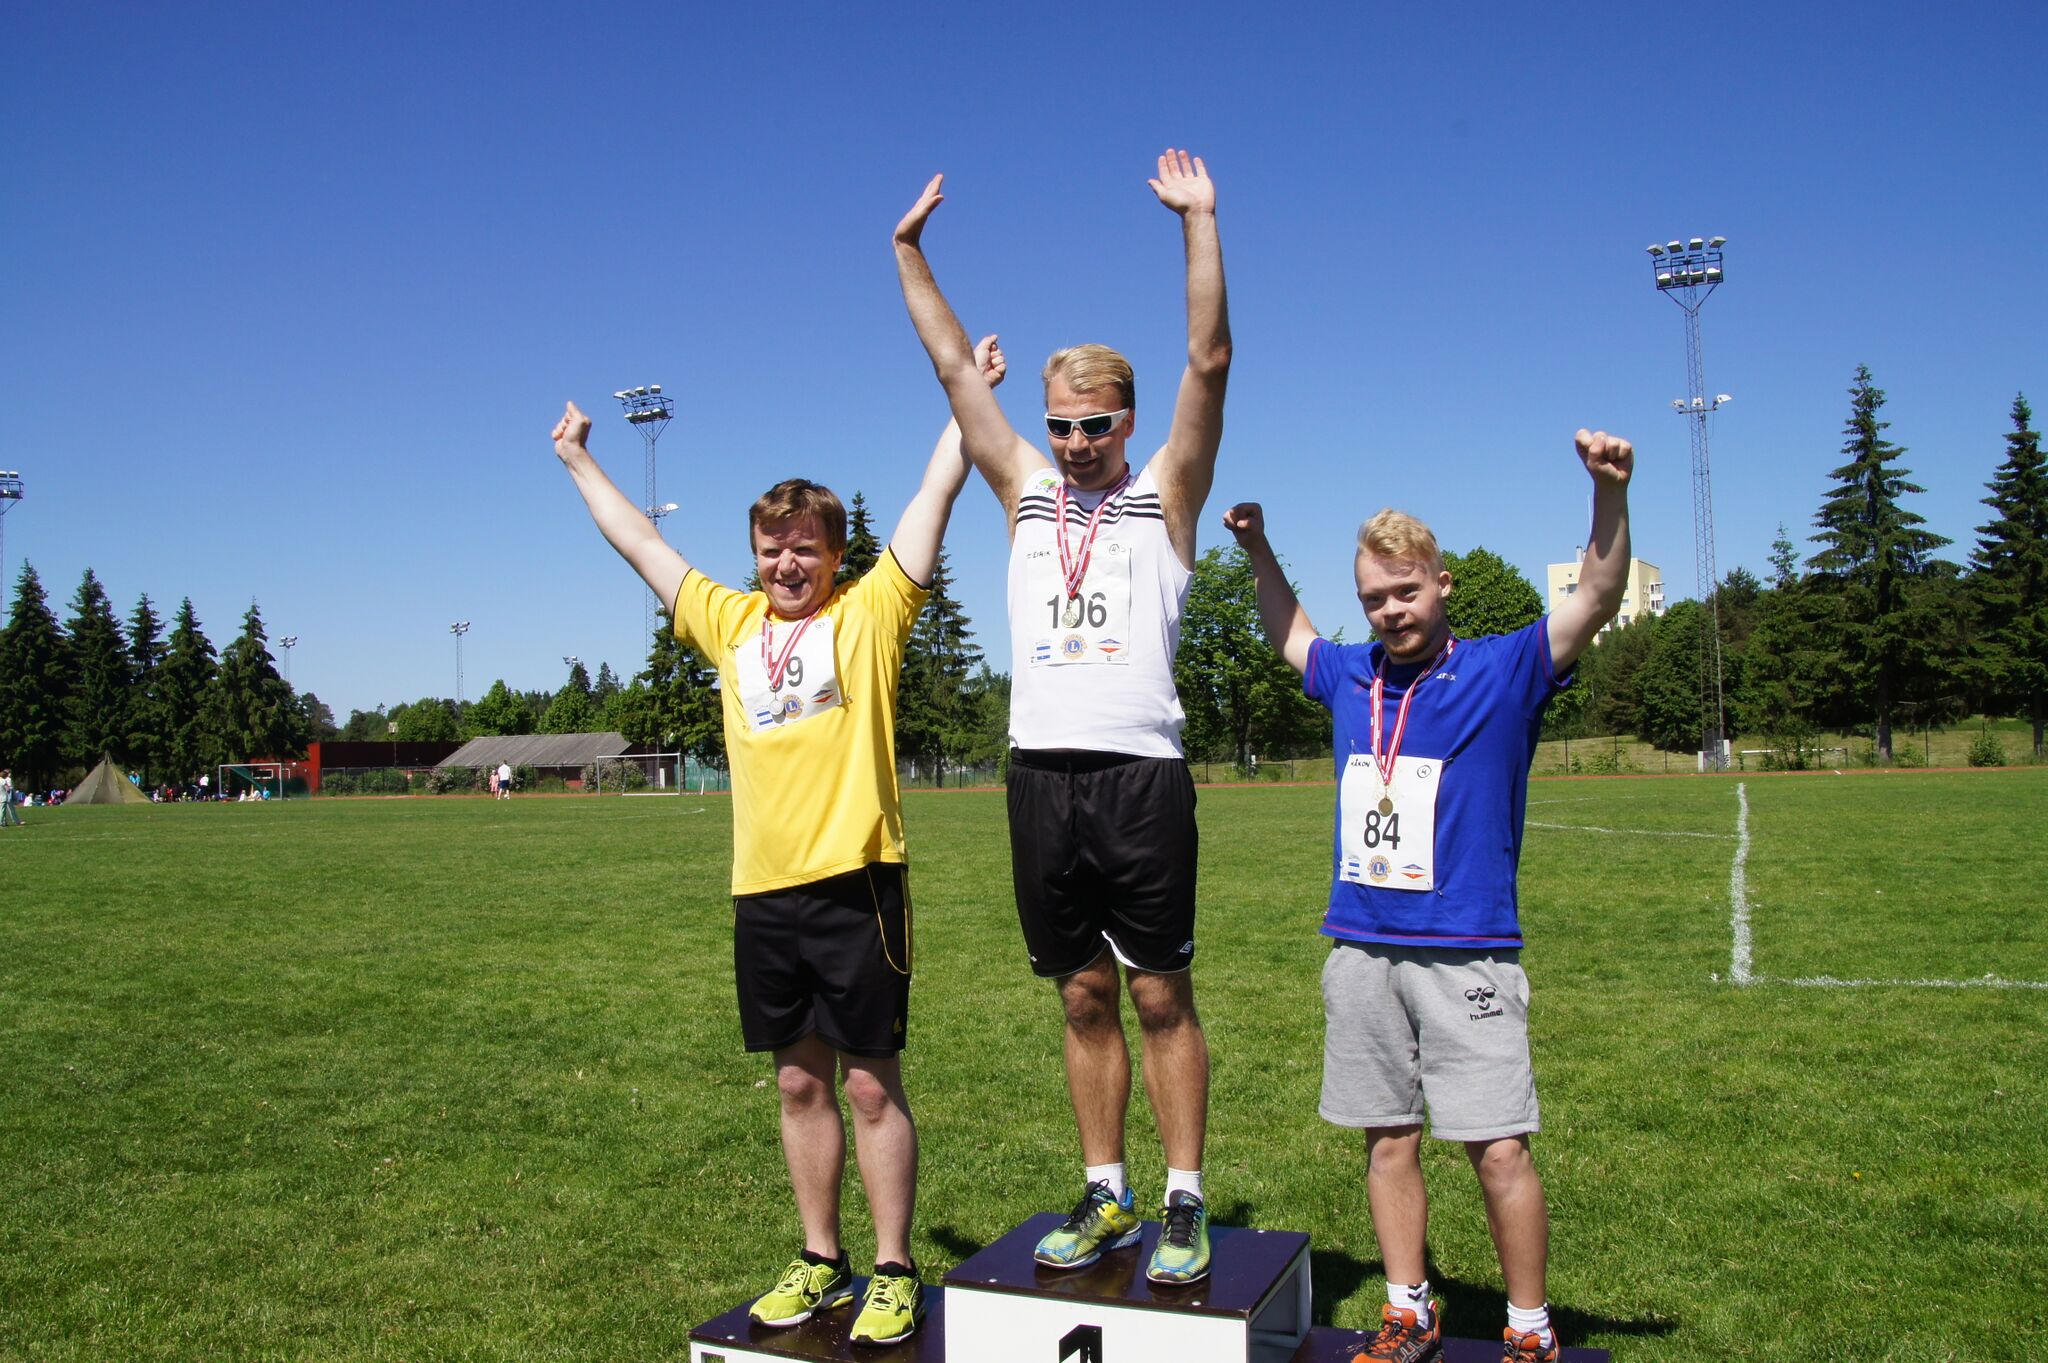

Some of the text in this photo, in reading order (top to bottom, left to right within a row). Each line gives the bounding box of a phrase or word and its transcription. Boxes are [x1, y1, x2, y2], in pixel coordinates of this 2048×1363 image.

[1047, 592, 1107, 629] 106
[1363, 809, 1401, 850] 84
[1470, 1008, 1503, 1021] hummel
